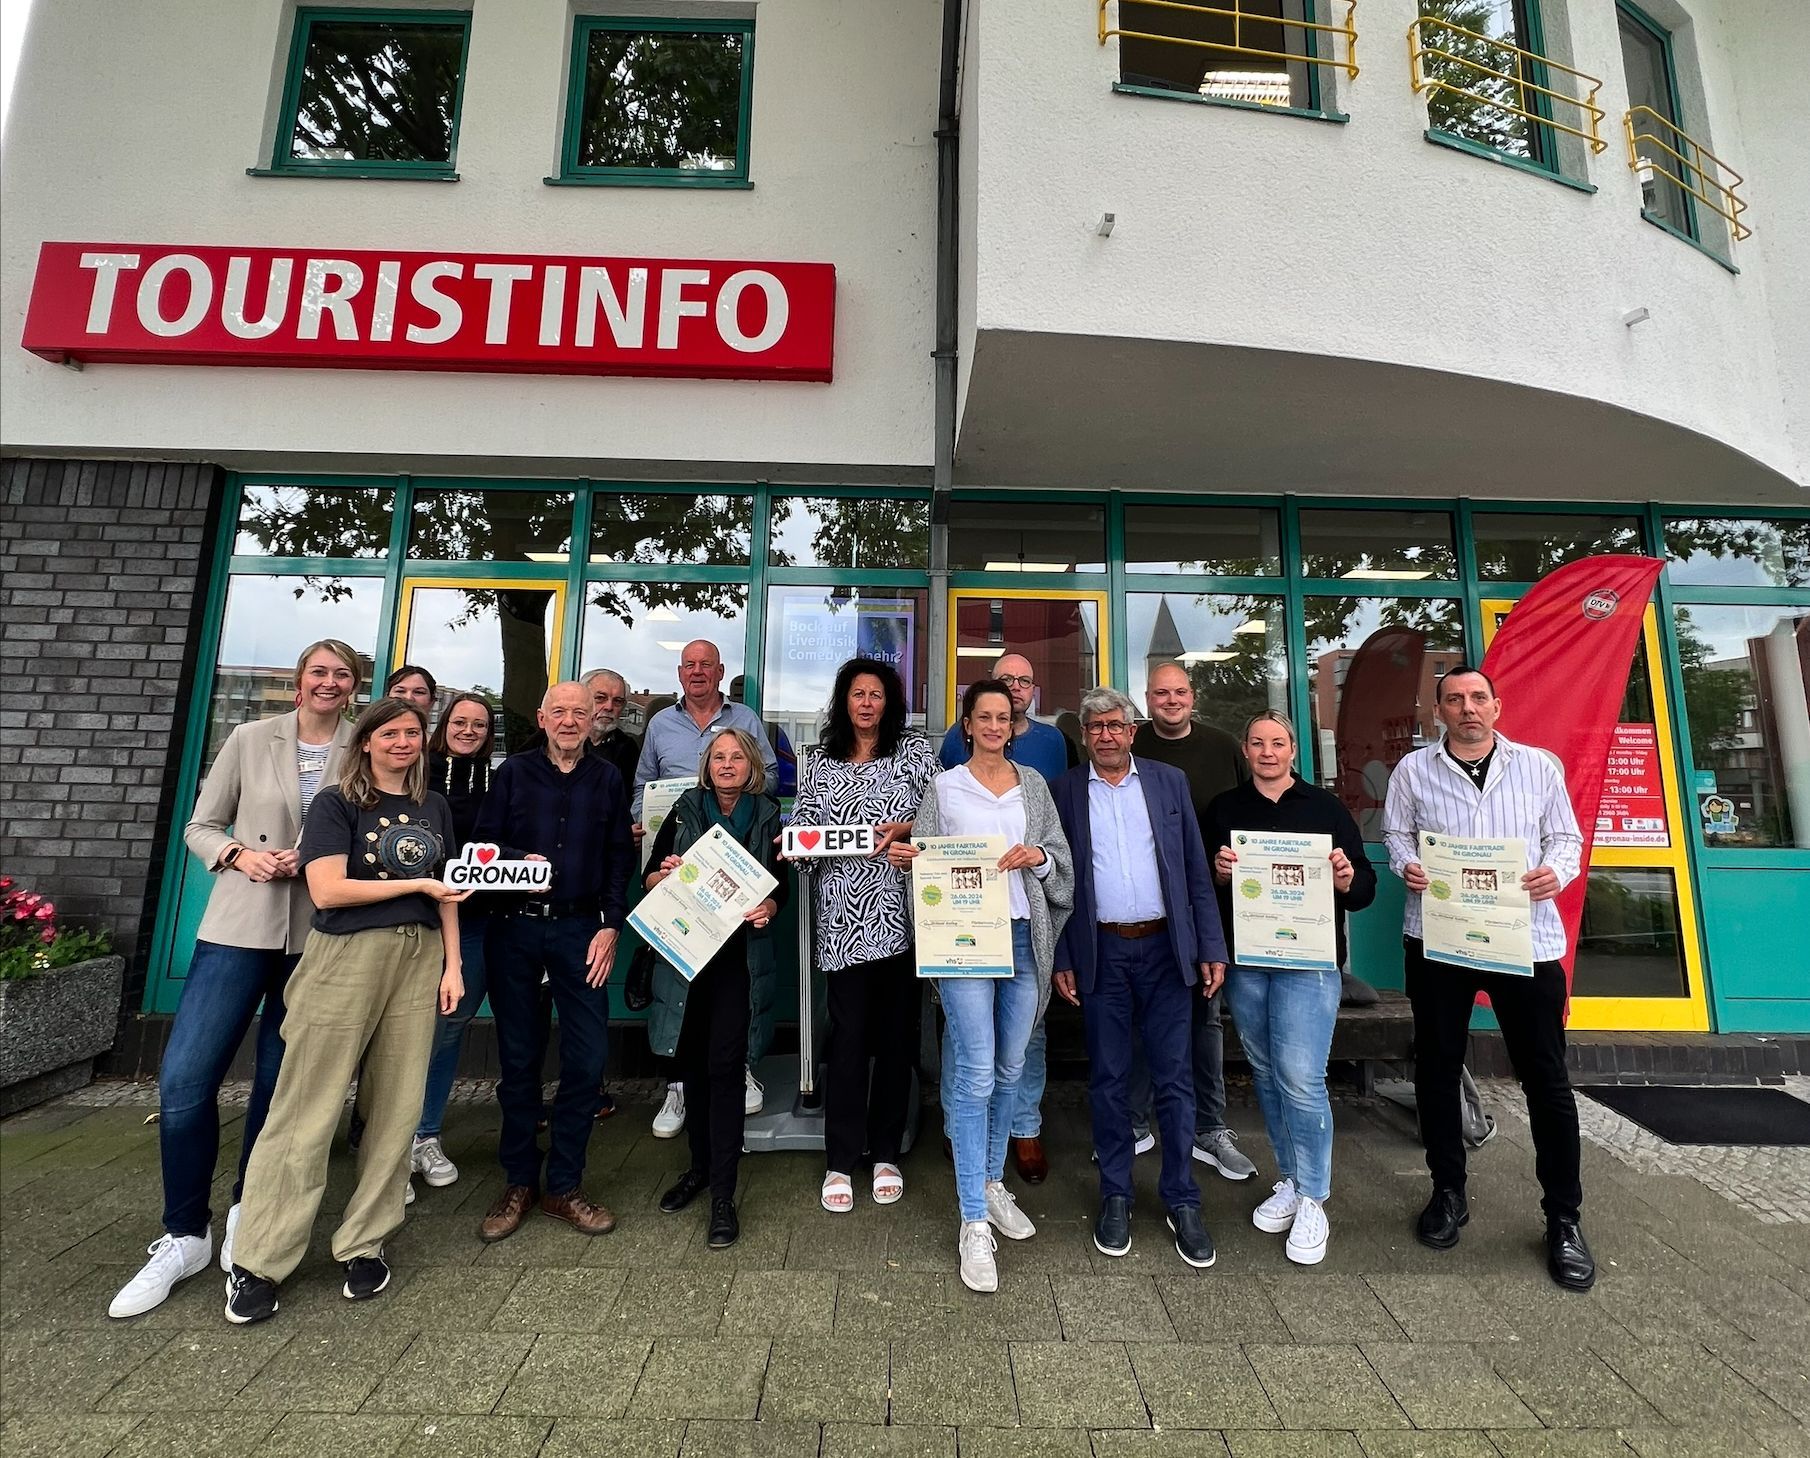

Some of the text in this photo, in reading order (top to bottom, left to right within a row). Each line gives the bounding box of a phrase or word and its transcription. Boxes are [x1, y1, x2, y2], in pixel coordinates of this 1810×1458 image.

[79, 252, 790, 354] TOURISTINFO
[790, 620, 848, 632] Bock auf
[789, 634, 857, 648] Livemusik
[788, 648, 842, 663] Comedy
[1618, 736, 1653, 744] Welcome
[788, 828, 868, 851] I EPE
[467, 848, 473, 865] I
[451, 866, 548, 884] GRONAU
